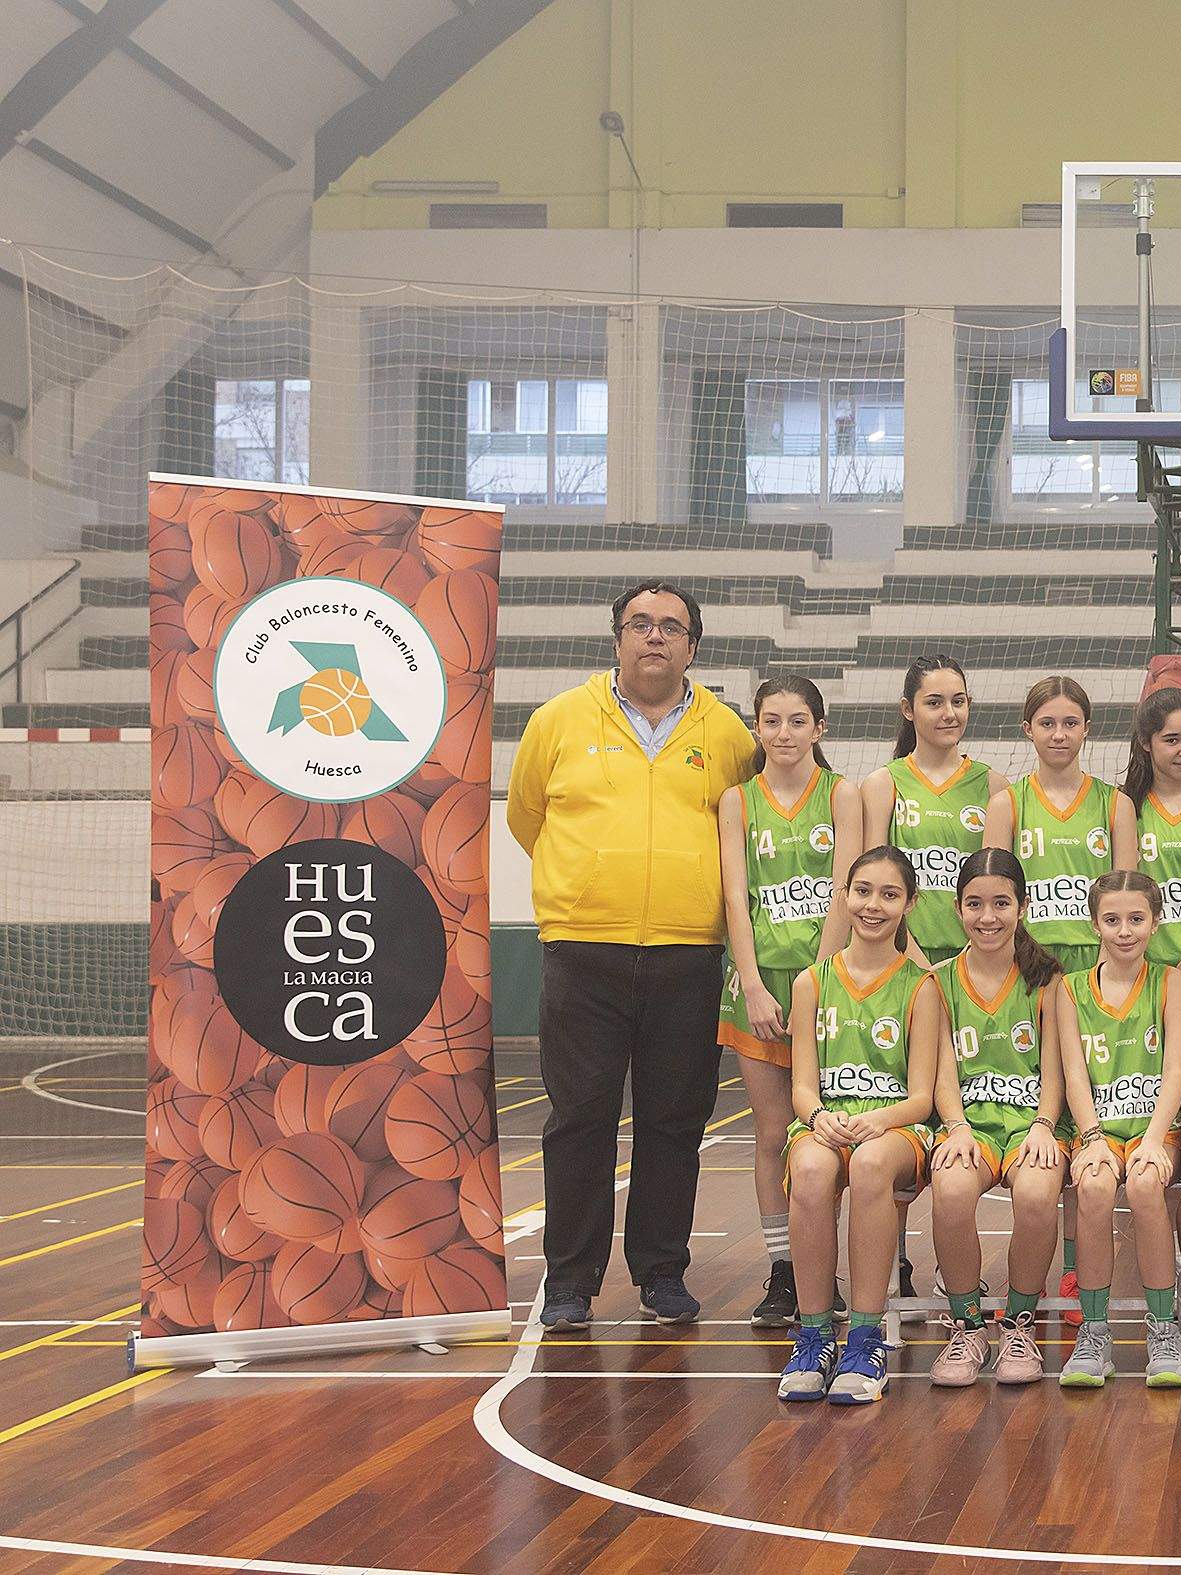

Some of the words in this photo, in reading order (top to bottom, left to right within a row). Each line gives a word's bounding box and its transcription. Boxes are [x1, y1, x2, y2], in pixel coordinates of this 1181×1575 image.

[1119, 373, 1138, 383] FIBA
[245, 632, 270, 665] Club
[268, 602, 359, 631] Baloncesto
[363, 609, 419, 673] Femenino
[304, 760, 362, 777] Huesca
[1020, 827, 1045, 860] 81
[283, 909, 376, 965] es
[283, 990, 379, 1042] ca
[1080, 1033, 1110, 1065] 75
